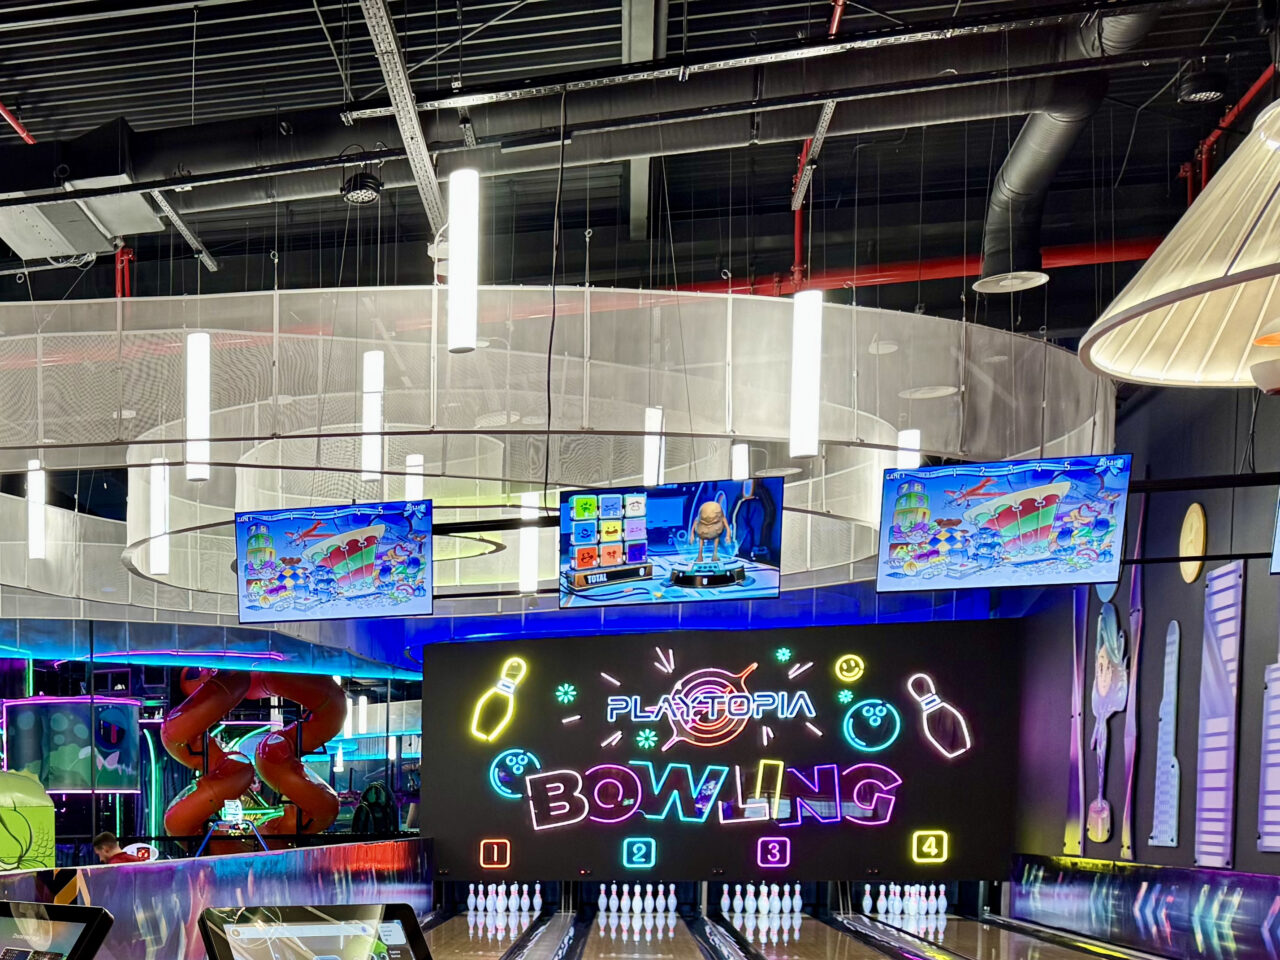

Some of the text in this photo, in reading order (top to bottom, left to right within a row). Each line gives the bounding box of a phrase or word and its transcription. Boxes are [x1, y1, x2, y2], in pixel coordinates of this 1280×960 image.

[587, 572, 608, 584] TOTAL
[607, 689, 817, 723] PLAYTOPIA
[525, 758, 904, 831] BOWLING
[633, 843, 647, 862] 2
[767, 842, 781, 862] 3
[922, 836, 939, 857] 4
